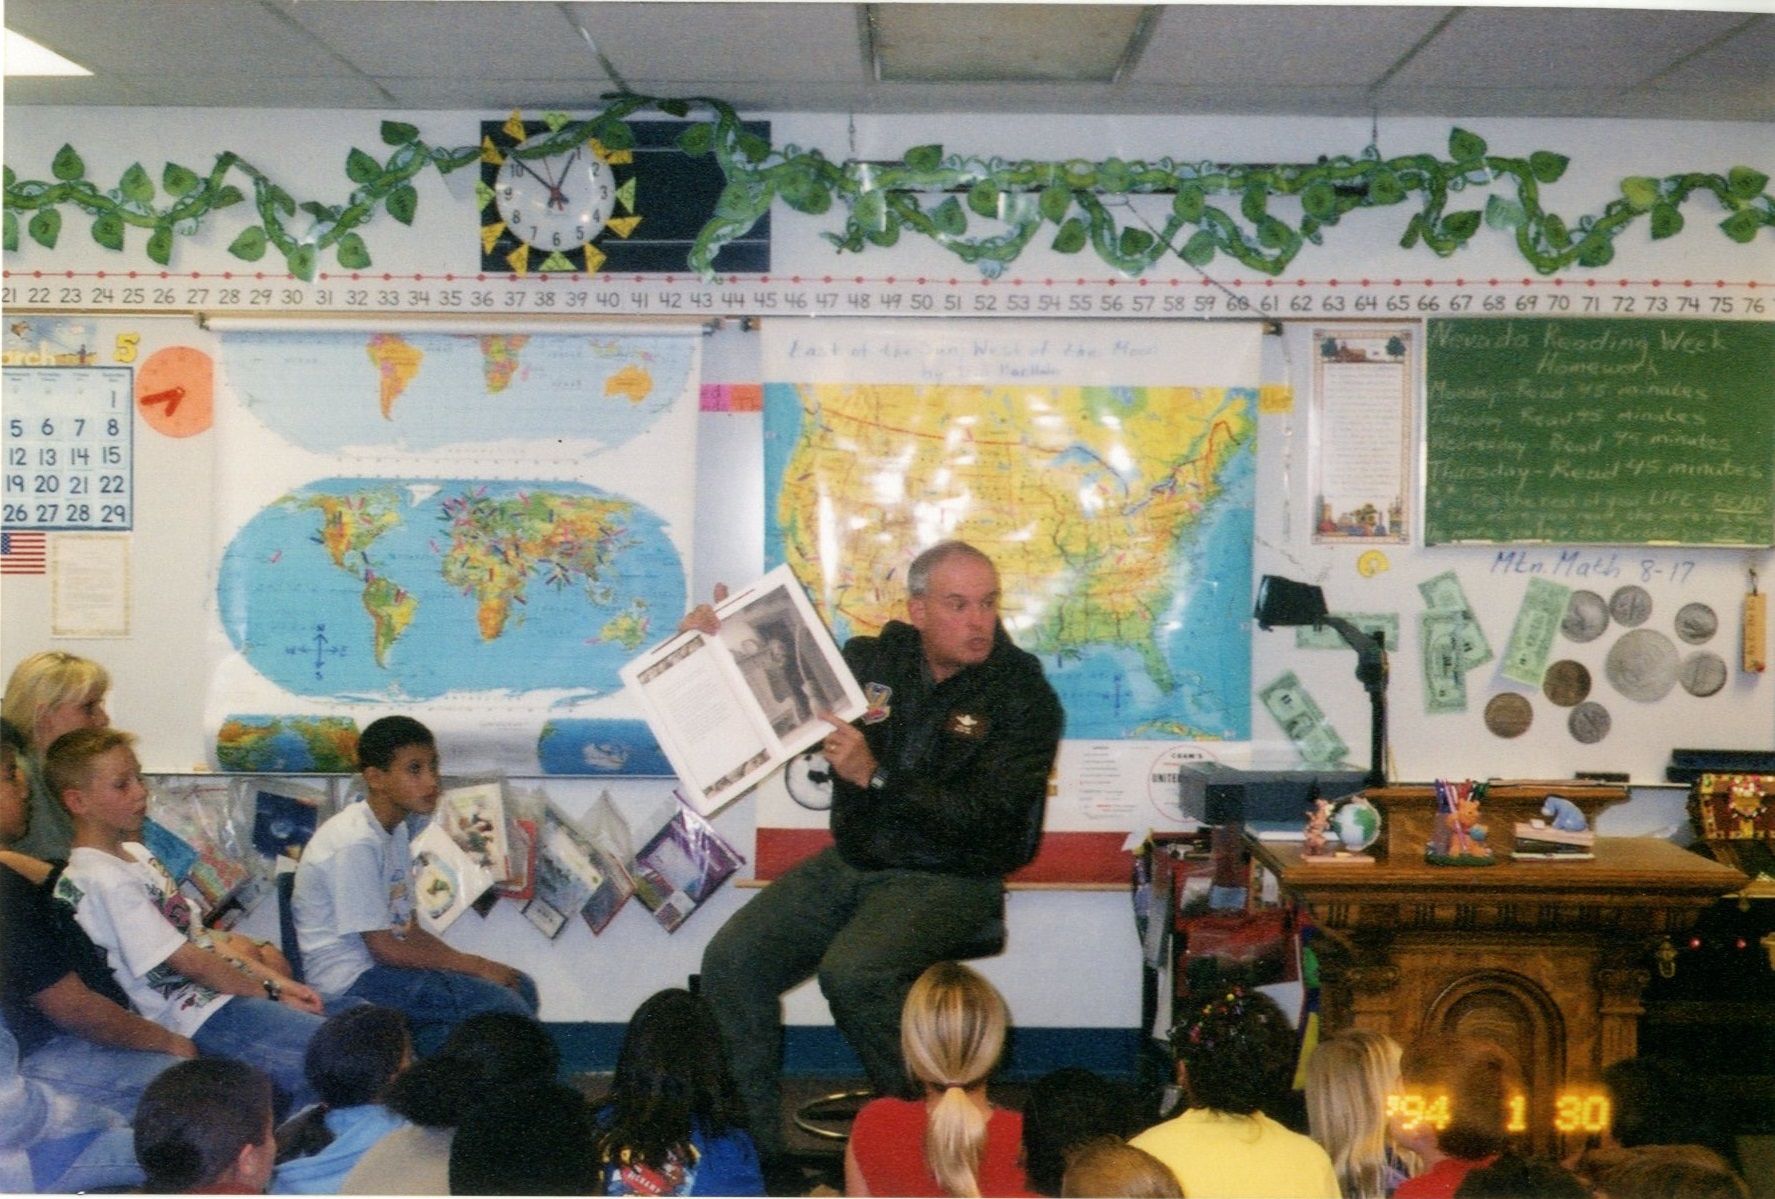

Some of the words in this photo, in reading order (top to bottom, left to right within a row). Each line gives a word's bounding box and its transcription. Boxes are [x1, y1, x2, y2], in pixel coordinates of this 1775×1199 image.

[510, 163, 524, 177] 10
[592, 162, 600, 177] 2
[503, 187, 512, 200] 9
[600, 185, 608, 200] 3
[512, 210, 521, 224] 8
[593, 209, 601, 223] 4
[530, 226, 538, 240] 7
[552, 232, 561, 246] 6
[576, 226, 584, 240] 5
[27, 287, 51, 304] 22
[59, 287, 83, 304] 23
[91, 287, 115, 304] 24
[122, 287, 145, 305] 25
[152, 287, 176, 305] 26
[186, 288, 210, 305] 27
[218, 288, 242, 305] 28
[249, 288, 273, 306] 29
[280, 288, 304, 305] 30
[315, 289, 333, 306] 31
[345, 289, 369, 307] 32
[376, 289, 400, 307] 33
[407, 290, 431, 307] 34
[438, 289, 463, 307] 35
[470, 290, 495, 308] 36
[503, 290, 527, 307] 37
[534, 290, 556, 308] 38
[565, 291, 588, 308] 39
[596, 291, 621, 308] 40
[630, 291, 649, 309] 41
[658, 291, 682, 309] 42
[689, 292, 713, 309] 43
[721, 292, 746, 309] 44
[753, 291, 777, 308] 45
[784, 292, 808, 309] 46
[815, 292, 839, 309] 47
[847, 293, 871, 310] 48
[880, 293, 903, 309] 49
[910, 293, 934, 311] 50
[943, 294, 962, 312] 51
[973, 294, 997, 312] 52
[1006, 294, 1030, 311] 53
[1037, 294, 1061, 311] 54
[1068, 294, 1092, 312] 55
[1100, 294, 1124, 312] 56
[1131, 295, 1156, 313] 57
[1162, 295, 1186, 313] 58
[1193, 294, 1217, 312] 59
[1226, 294, 1251, 312] 60
[1259, 294, 1279, 312] 61
[1289, 294, 1313, 312] 62
[1321, 295, 1346, 312] 63
[1353, 295, 1379, 312] 64
[1385, 294, 1411, 312] 65
[1416, 294, 1441, 312] 66
[1448, 294, 1474, 312] 67
[1482, 294, 1506, 312] 68
[1514, 294, 1539, 312] 69
[1547, 294, 1571, 312] 70
[1581, 294, 1601, 312] 71
[1611, 295, 1636, 313] 72
[1644, 295, 1669, 313] 73
[1676, 295, 1701, 313] 74
[1709, 296, 1734, 314] 75
[1742, 296, 1766, 314] 76
[113, 332, 140, 363] 5
[1430, 320, 1530, 349] Nevada
[1544, 320, 1648, 362] Reading
[1659, 327, 1728, 354] Week
[1537, 350, 1659, 376] Homework
[110, 389, 116, 408] 1
[1617, 405, 1708, 427] minutes
[10, 419, 23, 437] 5
[41, 418, 54, 437] 6
[74, 418, 86, 437] 7
[107, 418, 119, 437] 8
[1648, 432, 1732, 452] minutes
[9, 447, 27, 466] 12
[39, 448, 57, 466] 13
[71, 447, 90, 466] 14
[102, 446, 121, 464] 15
[1549, 458, 1621, 481] Read
[1624, 457, 1663, 476] 45
[1666, 458, 1763, 479] minutes
[6, 474, 25, 493] 19
[35, 475, 59, 493] 20
[69, 476, 89, 494] 21
[100, 476, 125, 493] 22
[3, 504, 28, 522] 26
[36, 504, 59, 522] 27
[66, 503, 90, 522] 28
[101, 504, 126, 522] 29
[1552, 551, 1621, 578] Math
[1640, 559, 1695, 584] 8-17
[1151, 773, 1181, 784] UNITE
